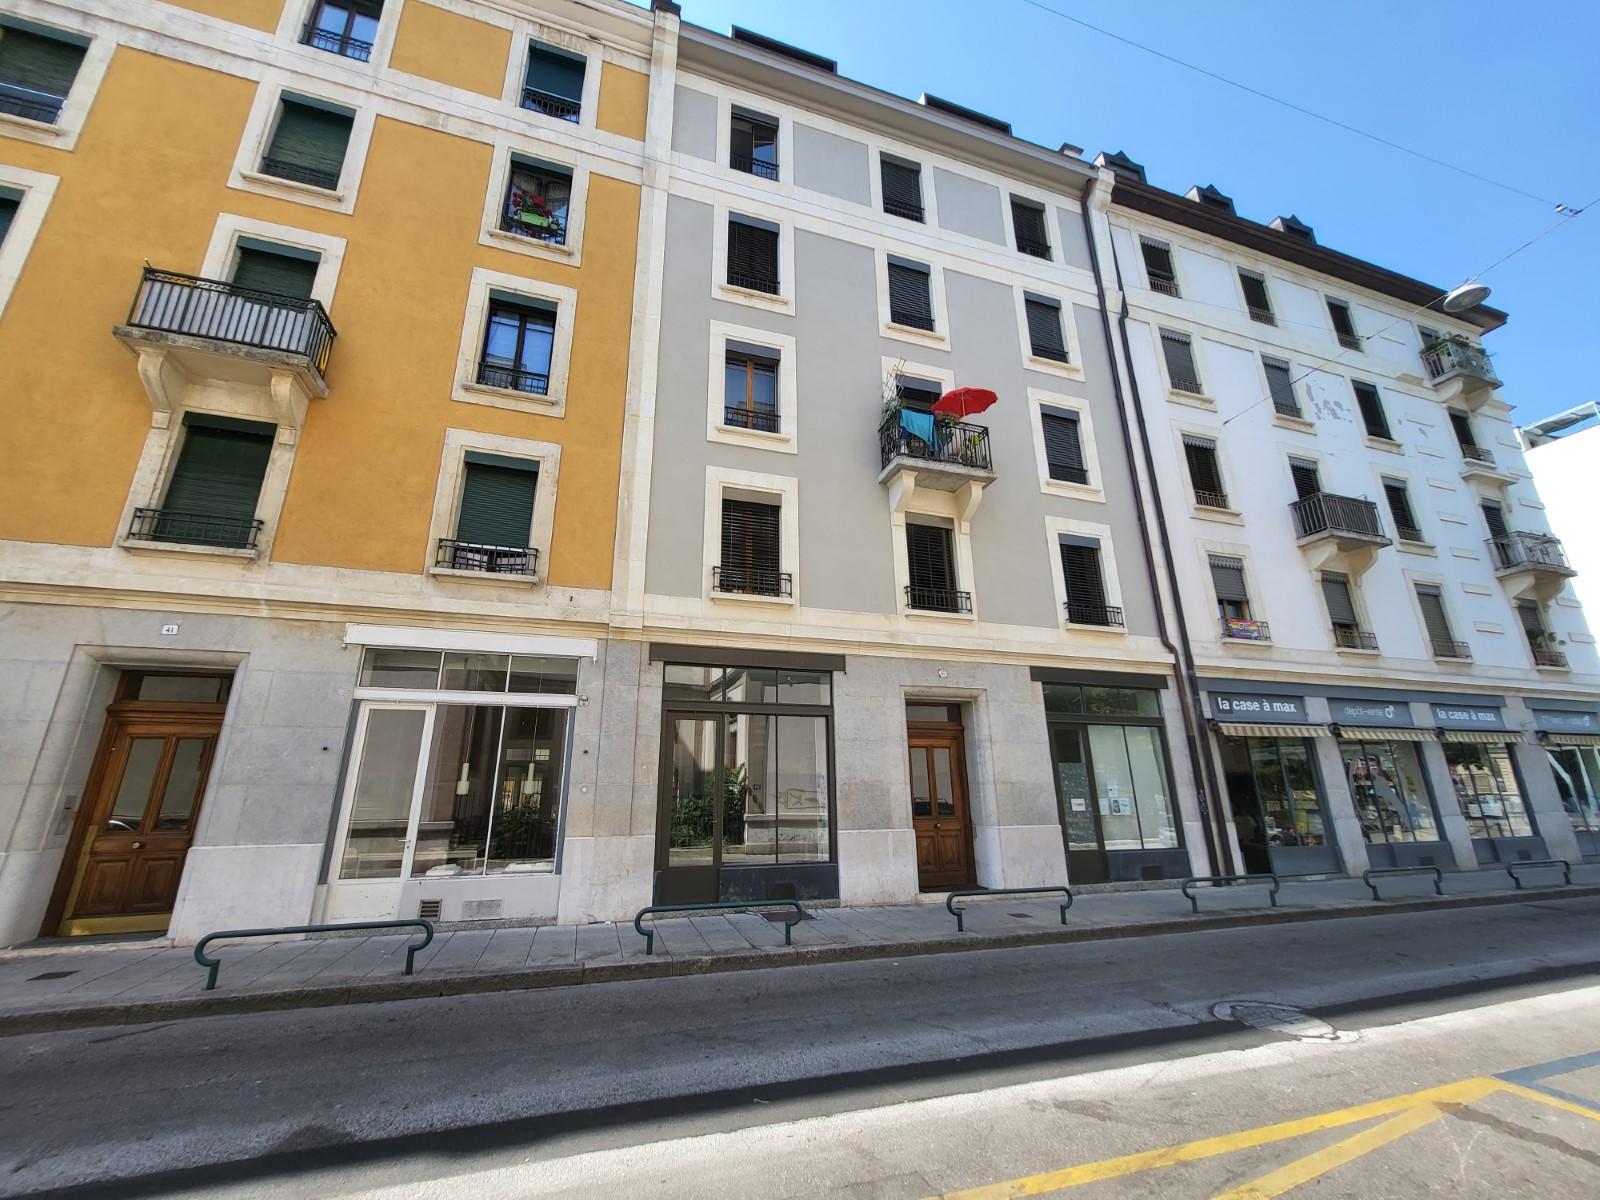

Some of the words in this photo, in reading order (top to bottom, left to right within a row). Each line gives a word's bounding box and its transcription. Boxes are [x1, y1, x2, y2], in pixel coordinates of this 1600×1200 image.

[1217, 697, 1230, 710] la
[1232, 700, 1260, 711] case
[1262, 699, 1270, 712] à
[1273, 702, 1297, 713] max
[1437, 709, 1447, 719] la
[1448, 710, 1469, 721] case
[1470, 709, 1477, 721] à
[1478, 712, 1497, 721] max
